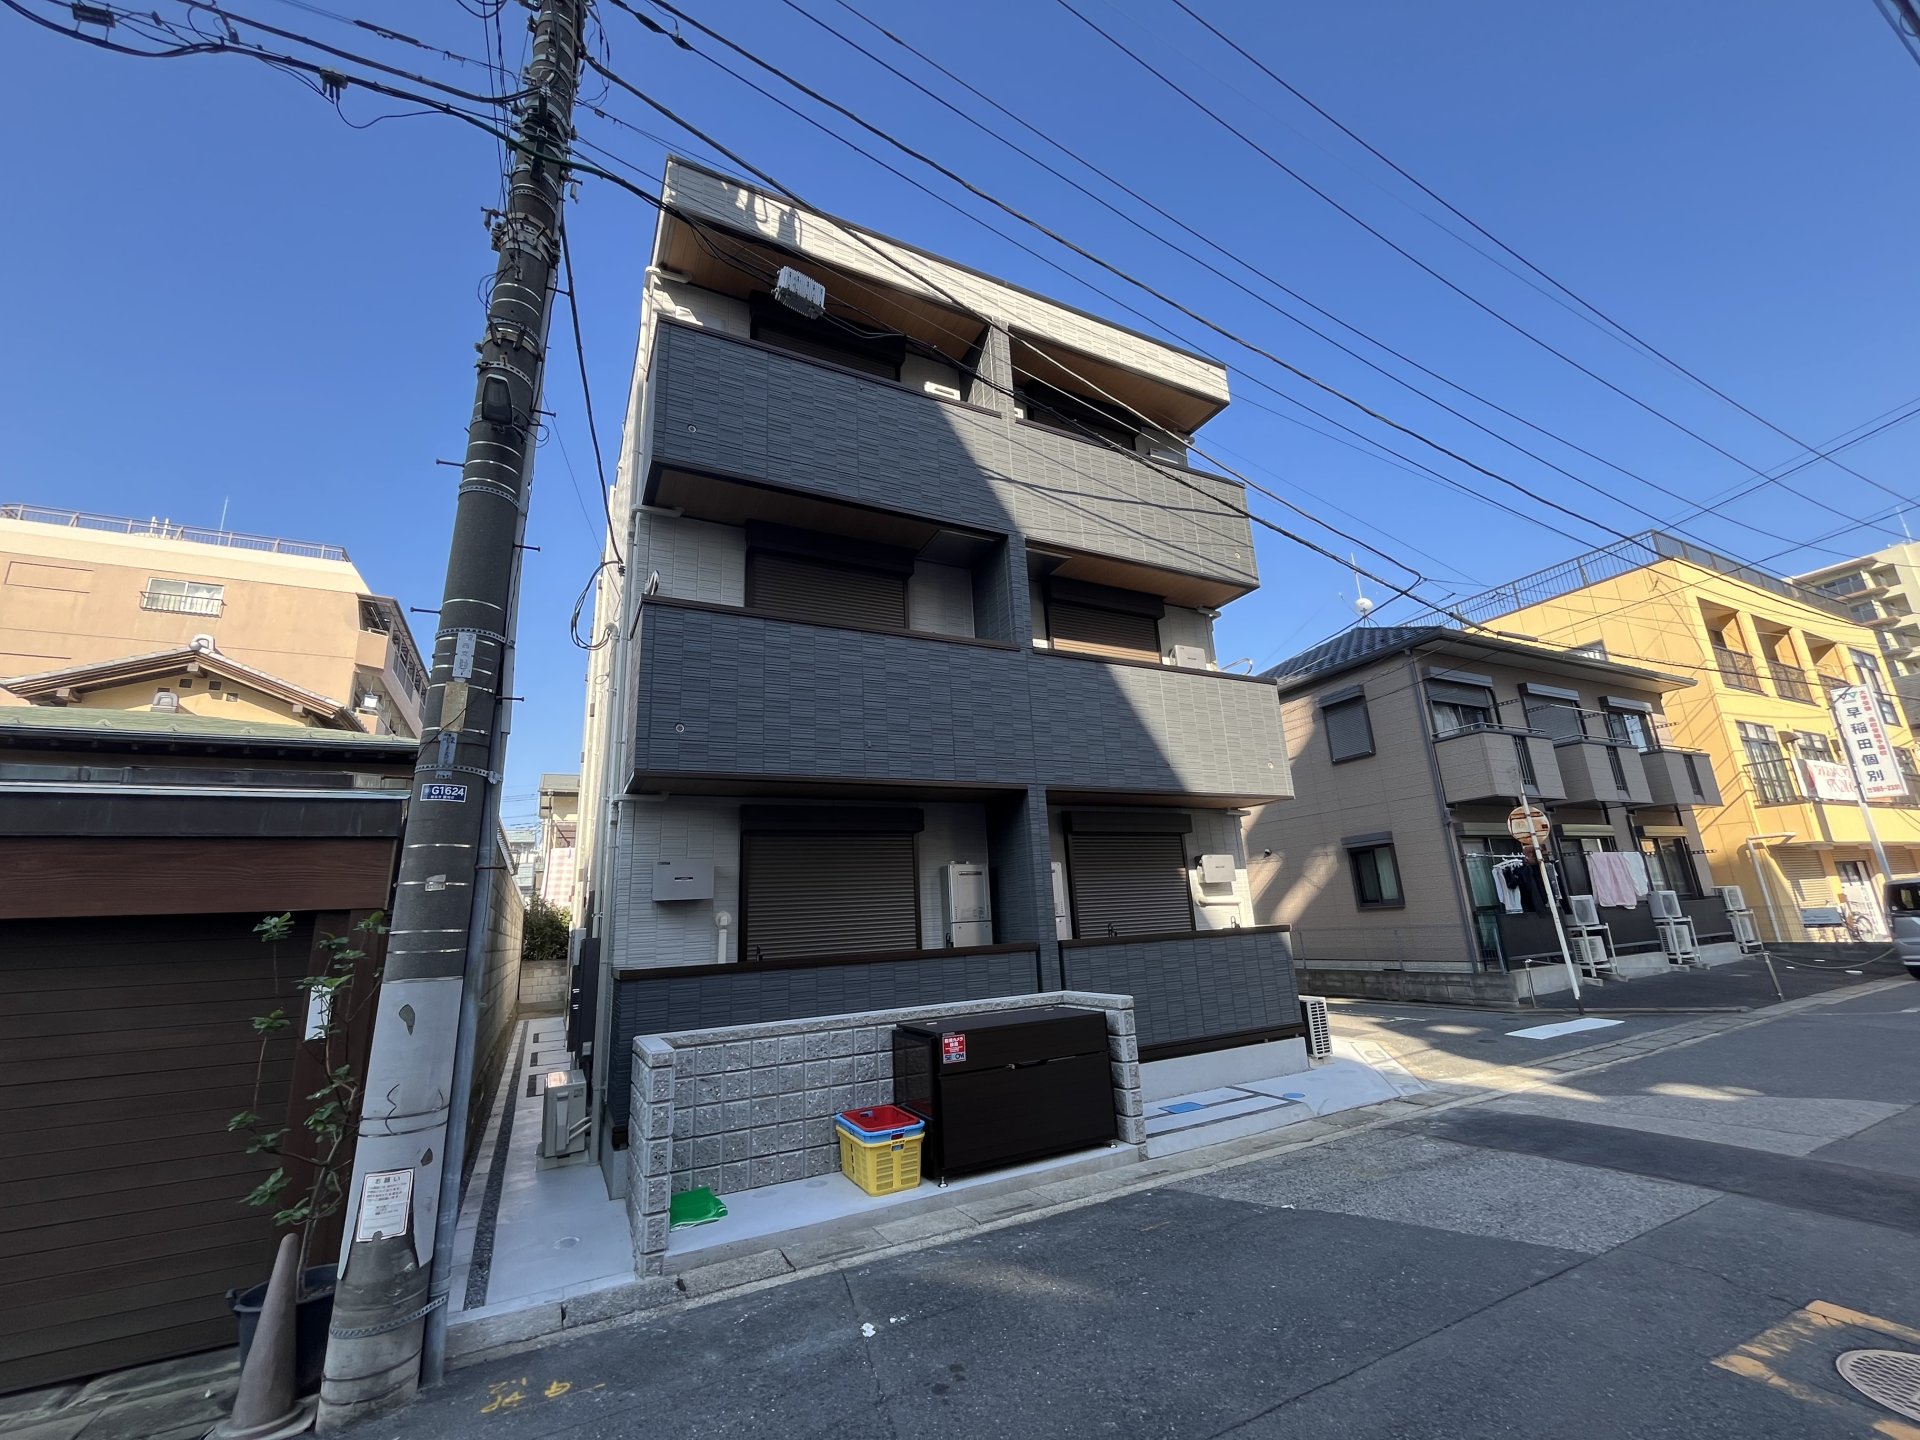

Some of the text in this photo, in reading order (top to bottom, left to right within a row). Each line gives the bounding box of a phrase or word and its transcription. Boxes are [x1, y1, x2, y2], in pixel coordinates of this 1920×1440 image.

[1846, 706, 1884, 782] 早稲田個別
[432, 786, 465, 796] G1624
